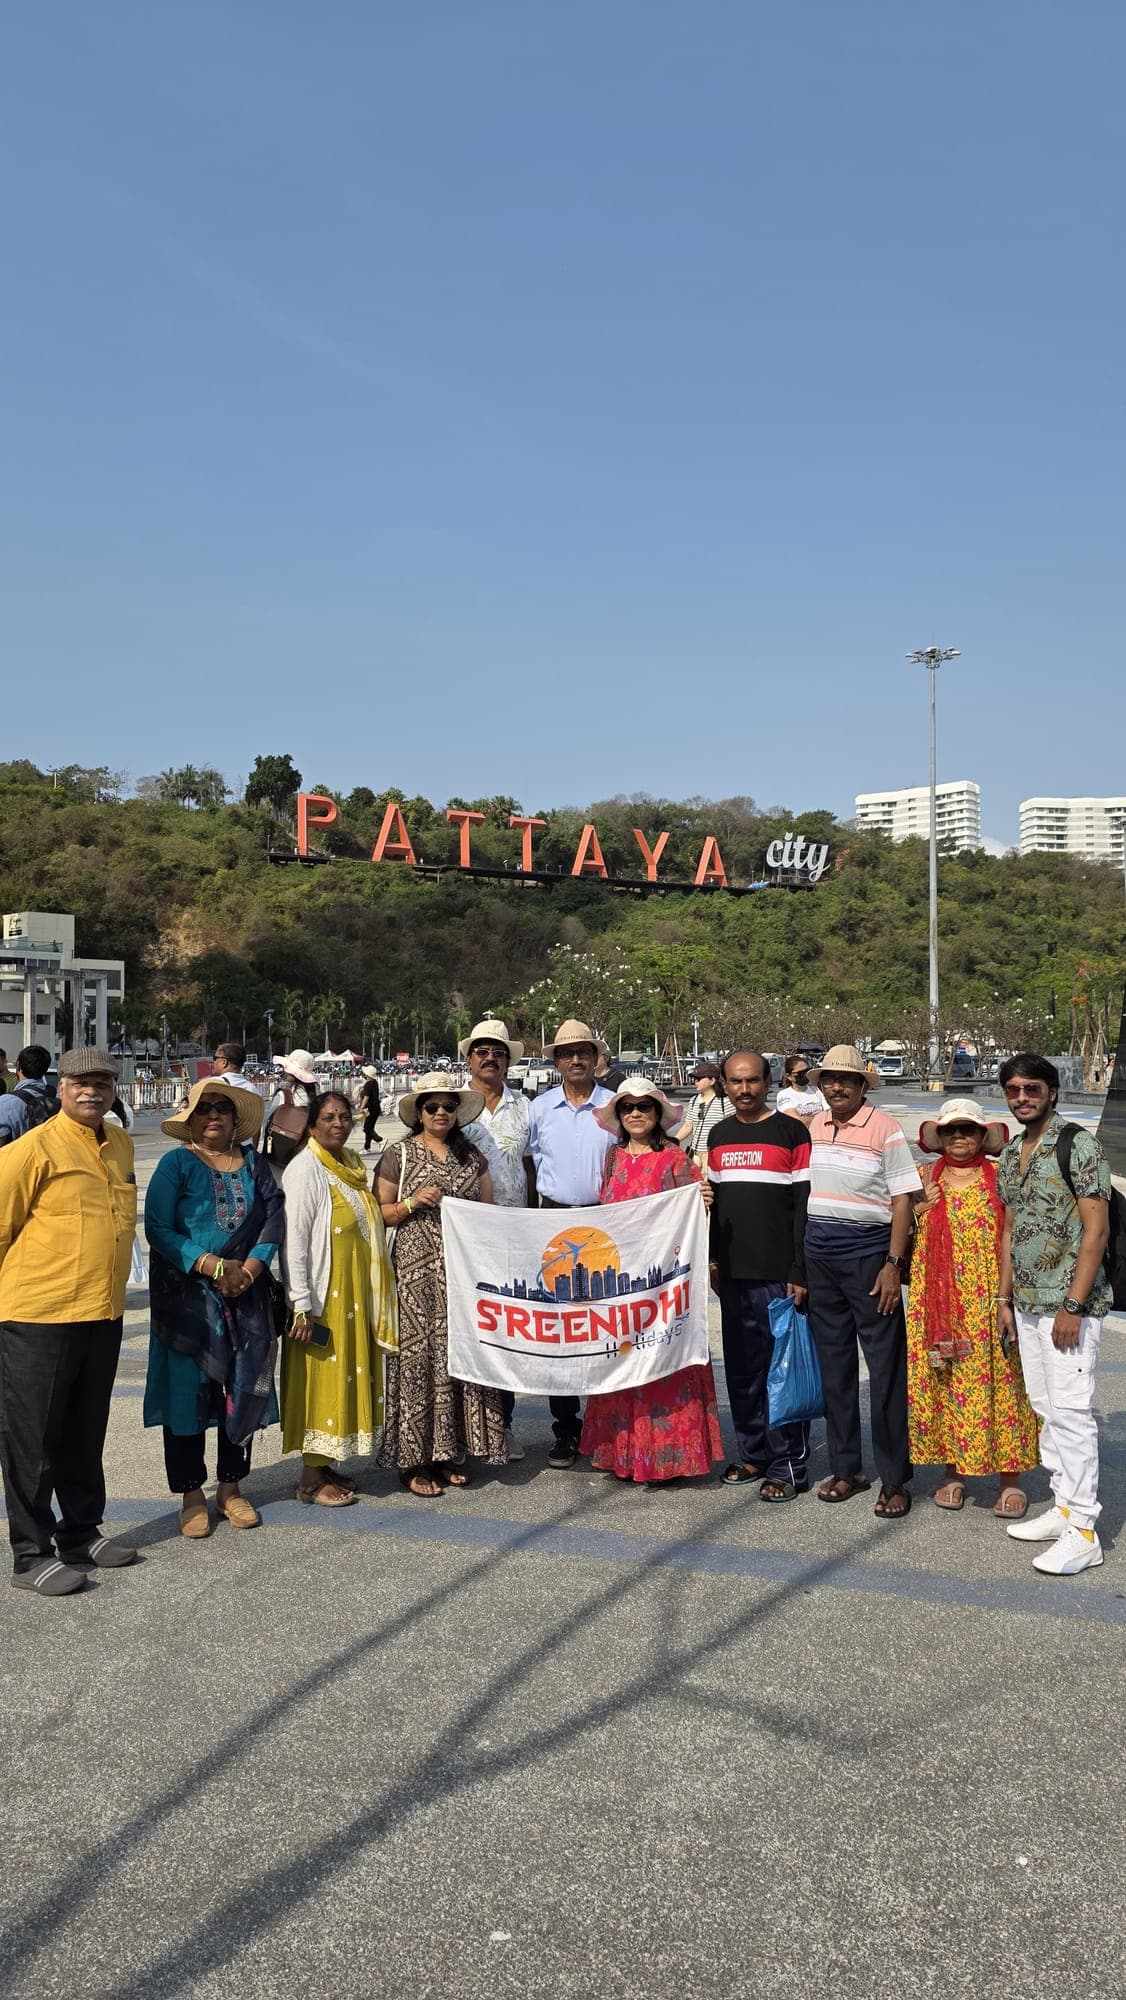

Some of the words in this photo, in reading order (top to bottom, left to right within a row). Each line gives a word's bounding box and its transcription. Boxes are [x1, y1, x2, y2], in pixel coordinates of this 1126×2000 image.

[298, 794, 727, 886] PATTAYA
[766, 832, 831, 882] city
[721, 1150, 763, 1167] PERFECTION
[476, 1279, 690, 1344] SREENIDHI
[605, 1323, 683, 1358] Holidays
